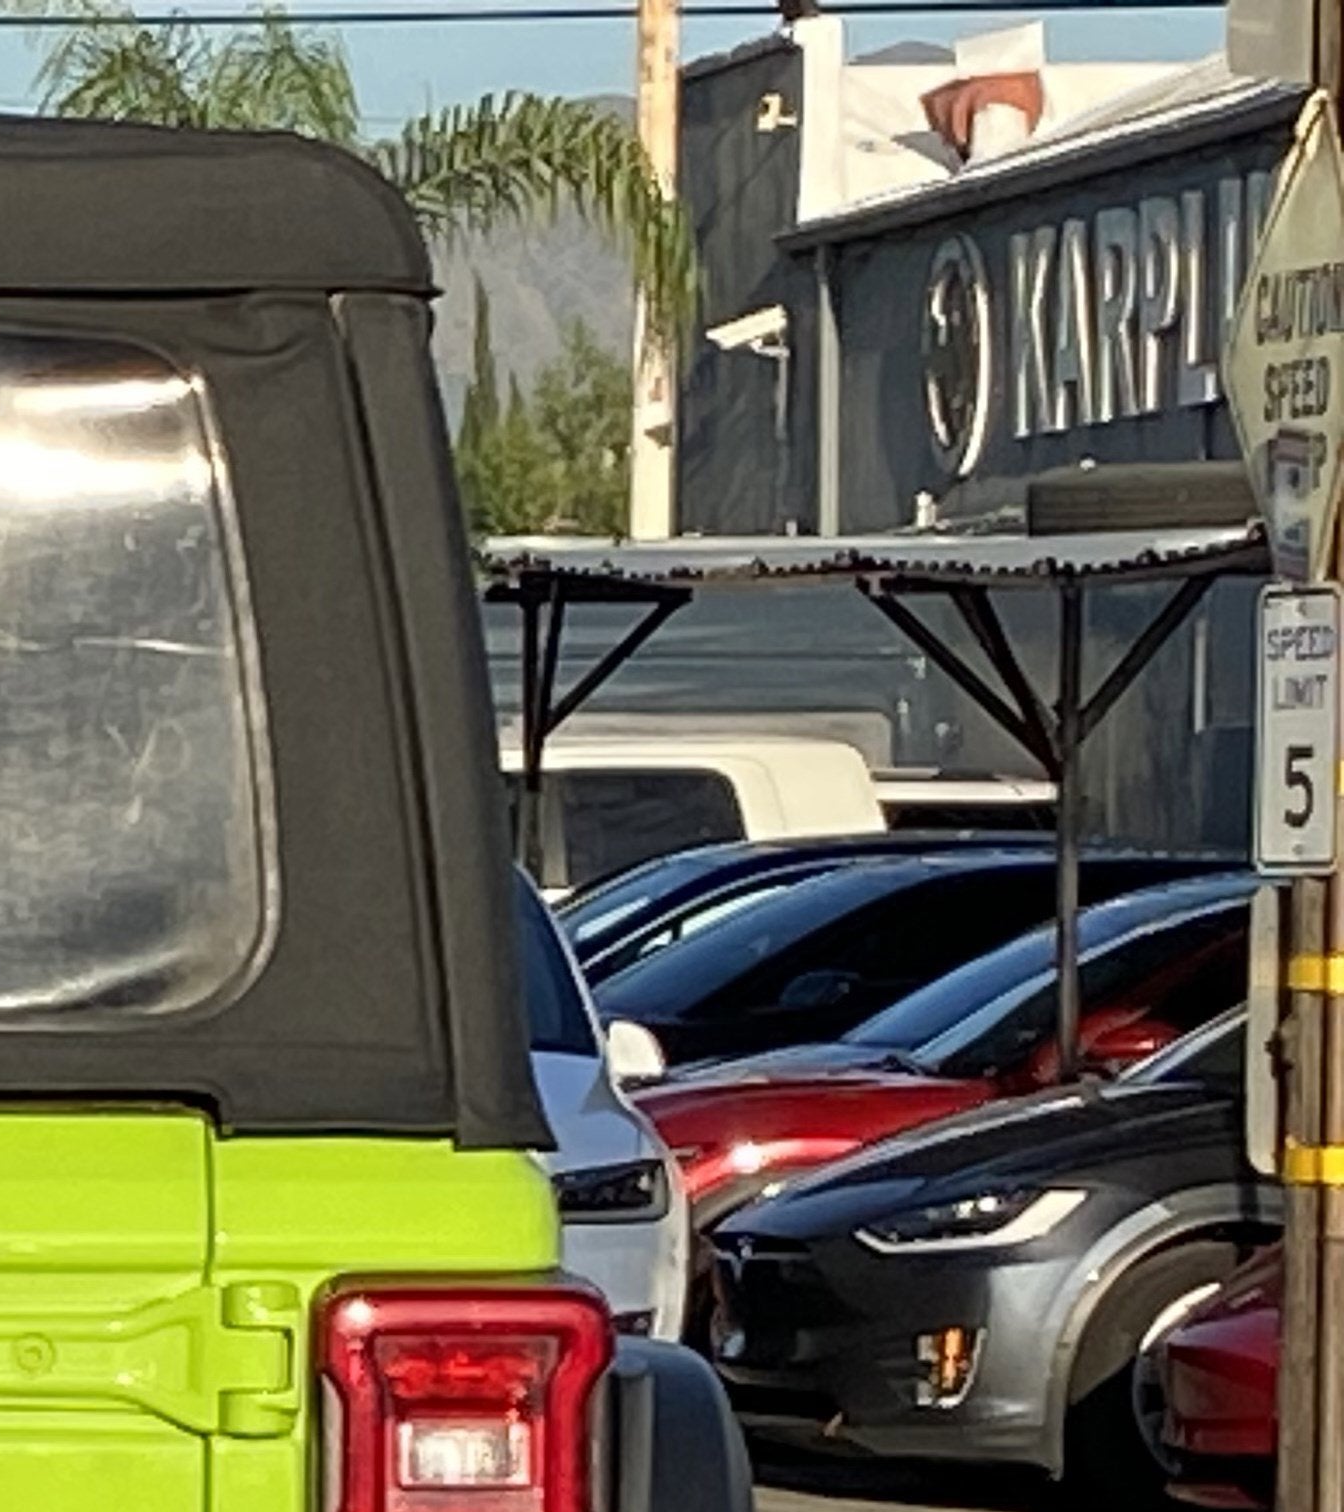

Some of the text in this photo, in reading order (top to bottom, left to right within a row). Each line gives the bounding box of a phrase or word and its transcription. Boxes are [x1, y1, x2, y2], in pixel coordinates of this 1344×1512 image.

[1264, 355, 1330, 421] SPEED
[1267, 625, 1335, 662] SPEED
[1273, 673, 1328, 711] LIMIT
[1284, 743, 1315, 829] 5
